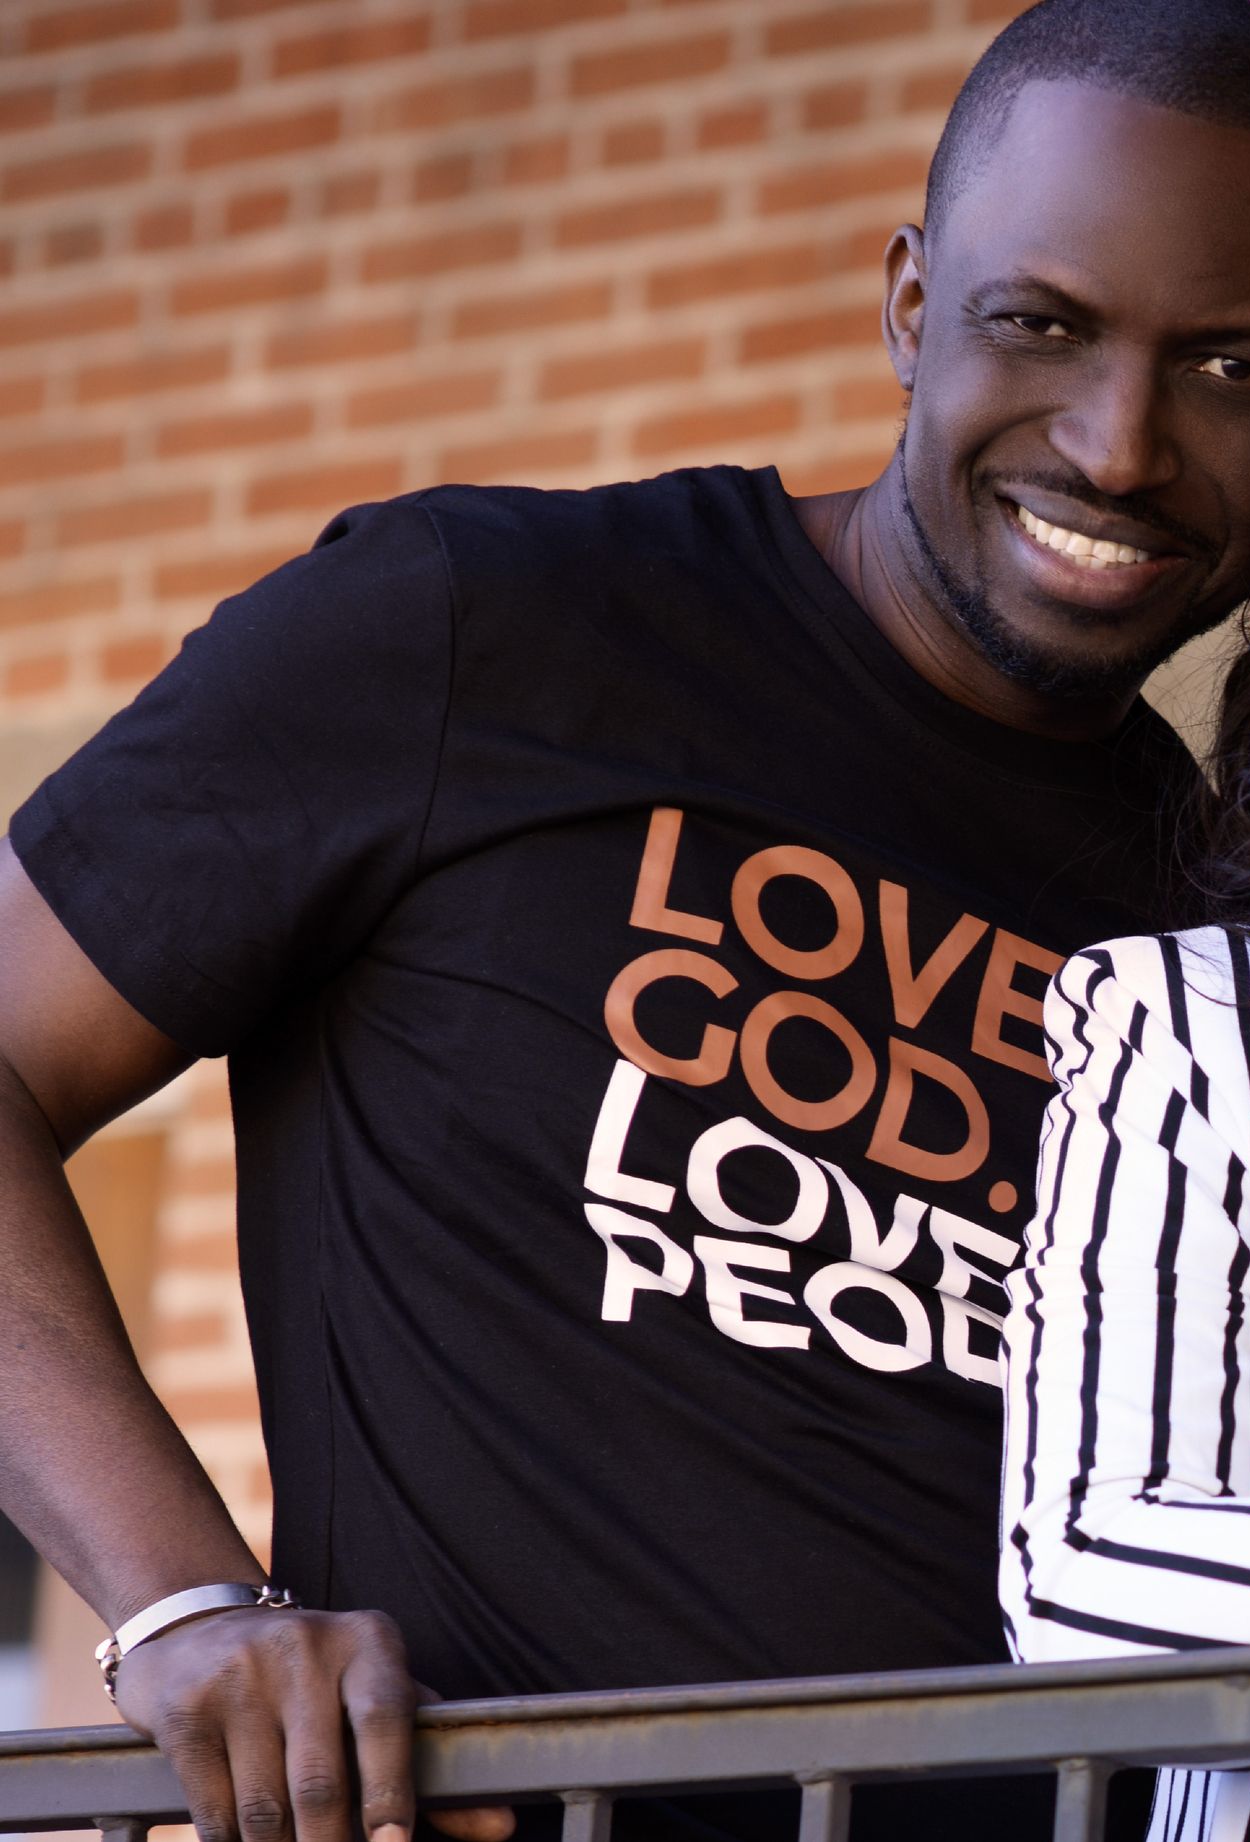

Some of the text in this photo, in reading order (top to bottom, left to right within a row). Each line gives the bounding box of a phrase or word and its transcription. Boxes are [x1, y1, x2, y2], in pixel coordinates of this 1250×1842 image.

[629, 806, 1066, 1083] LOVE
[584, 1058, 1021, 1299] LOVE
[604, 948, 1017, 1213] GOD.
